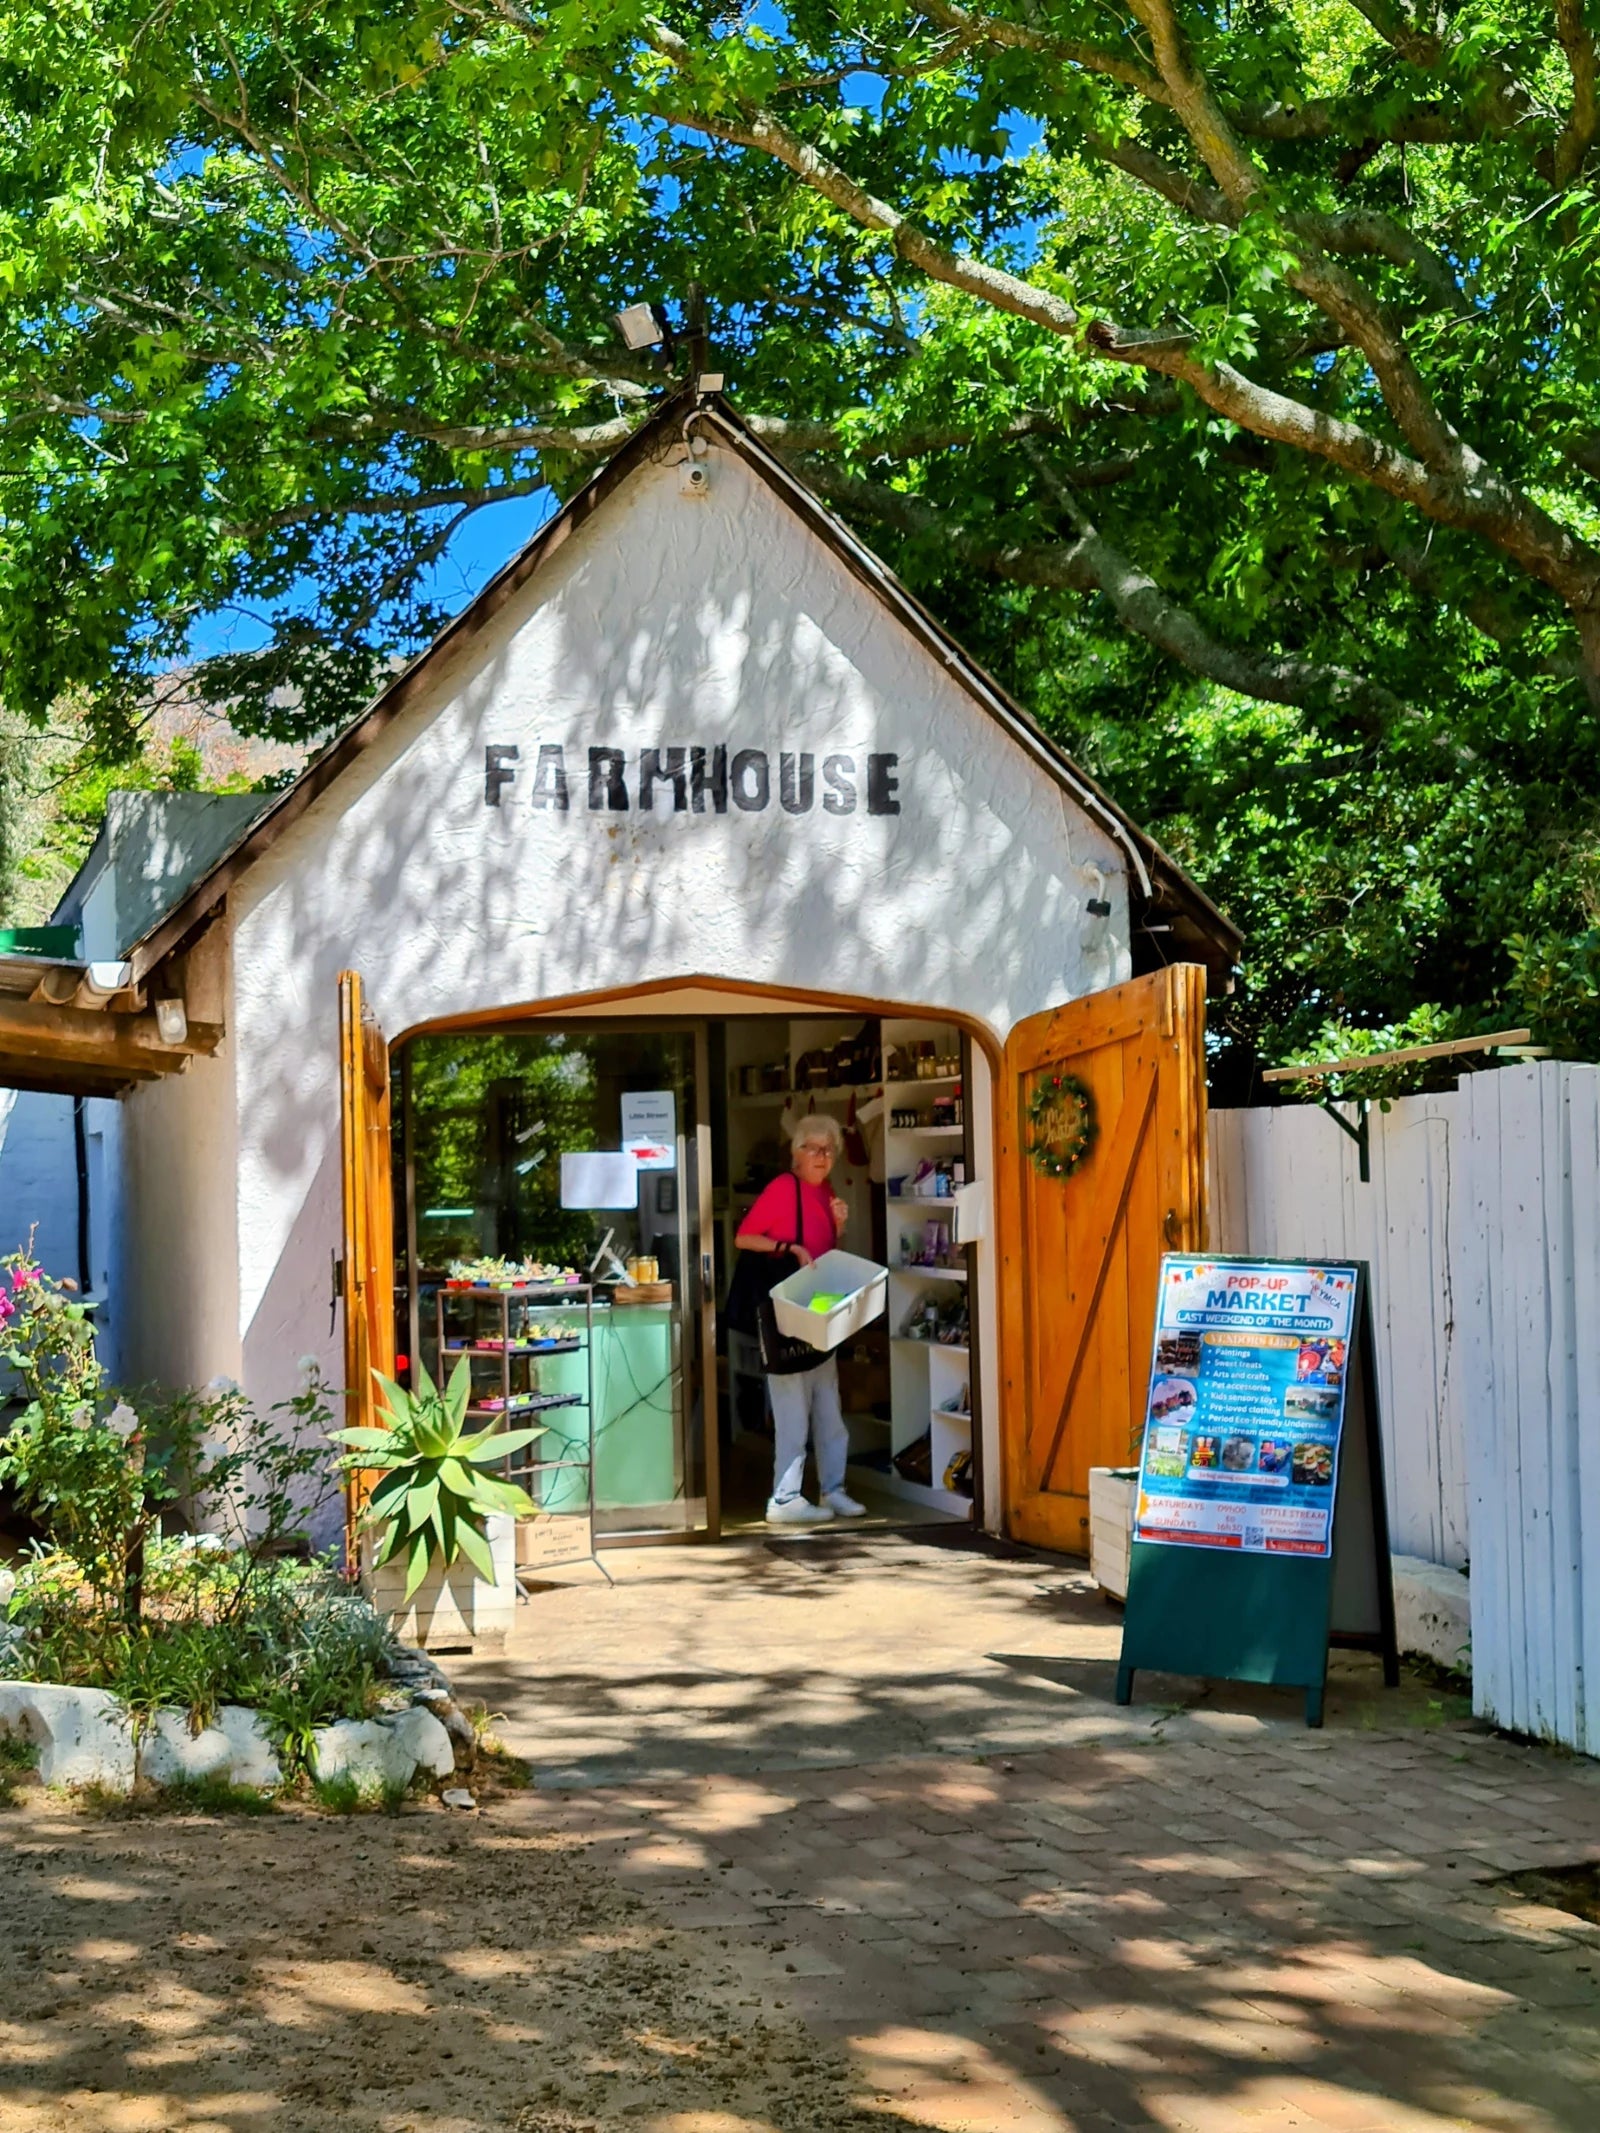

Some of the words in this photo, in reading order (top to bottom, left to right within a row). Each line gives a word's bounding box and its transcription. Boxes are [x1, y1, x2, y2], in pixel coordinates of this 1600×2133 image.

[485, 744, 901, 816] FARMHOUSE
[1227, 1276, 1288, 1290] POP-UP
[1206, 1290, 1311, 1312] MARKET
[1319, 1289, 1341, 1309] YMCA
[1177, 1312, 1203, 1322] LAST
[1205, 1313, 1253, 1325] WEEKEND
[1256, 1316, 1270, 1325] OF
[1272, 1317, 1292, 1327] THE
[1294, 1318, 1331, 1329] MONTH
[1215, 1348, 1250, 1358] Paintings
[1213, 1370, 1229, 1378] Arts
[1231, 1371, 1246, 1379] and
[1246, 1373, 1269, 1381] crafts
[1211, 1381, 1226, 1389] Pet
[1226, 1384, 1271, 1392] accessories
[1210, 1392, 1227, 1400] Kids
[1228, 1395, 1259, 1404] sensory
[1260, 1396, 1277, 1405] toys
[1210, 1403, 1247, 1412] Pre-loved
[1248, 1405, 1281, 1417] clothing
[1208, 1414, 1234, 1423] Period
[1235, 1415, 1283, 1428] Eco-friendly
[1284, 1419, 1327, 1429] Underwear
[1208, 1425, 1228, 1433] Little
[1229, 1426, 1257, 1436] Stream
[1258, 1429, 1287, 1438] Garden
[1152, 1499, 1205, 1511] SATURDAYS
[1261, 1508, 1286, 1517] LITTLE
[1289, 1510, 1326, 1520] STREAM
[1155, 1517, 1197, 1528] SUNDAYS
